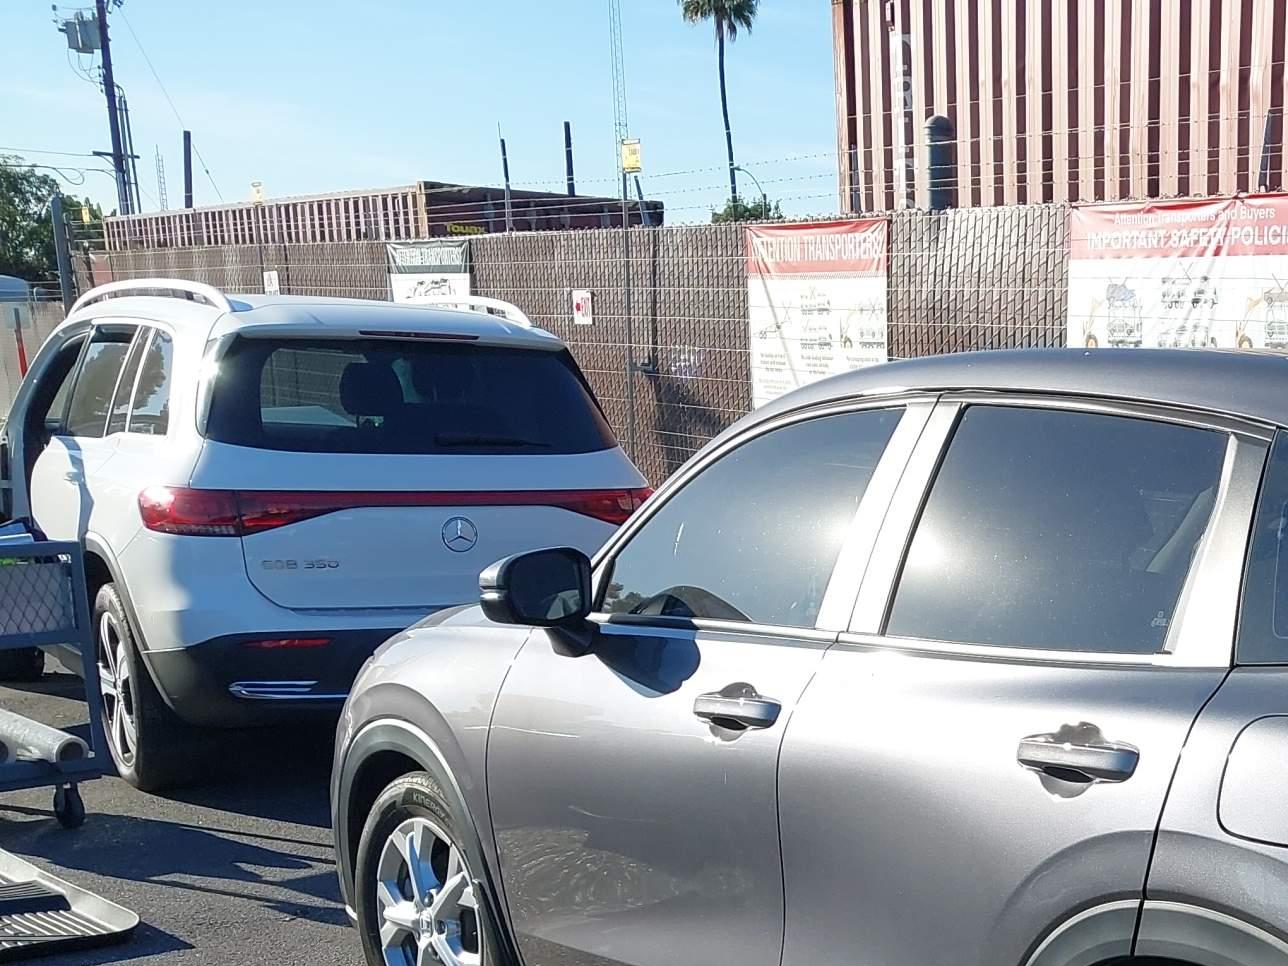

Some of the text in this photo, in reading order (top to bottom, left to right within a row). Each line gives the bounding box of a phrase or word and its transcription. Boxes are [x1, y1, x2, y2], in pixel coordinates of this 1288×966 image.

[1114, 212, 1154, 225] Attention
[1218, 208, 1237, 221] and
[1239, 206, 1276, 221] Buyers
[1087, 229, 1168, 250] IMPORTANT
[1170, 226, 1224, 248] SAFETY
[304, 560, 340, 569] 350
